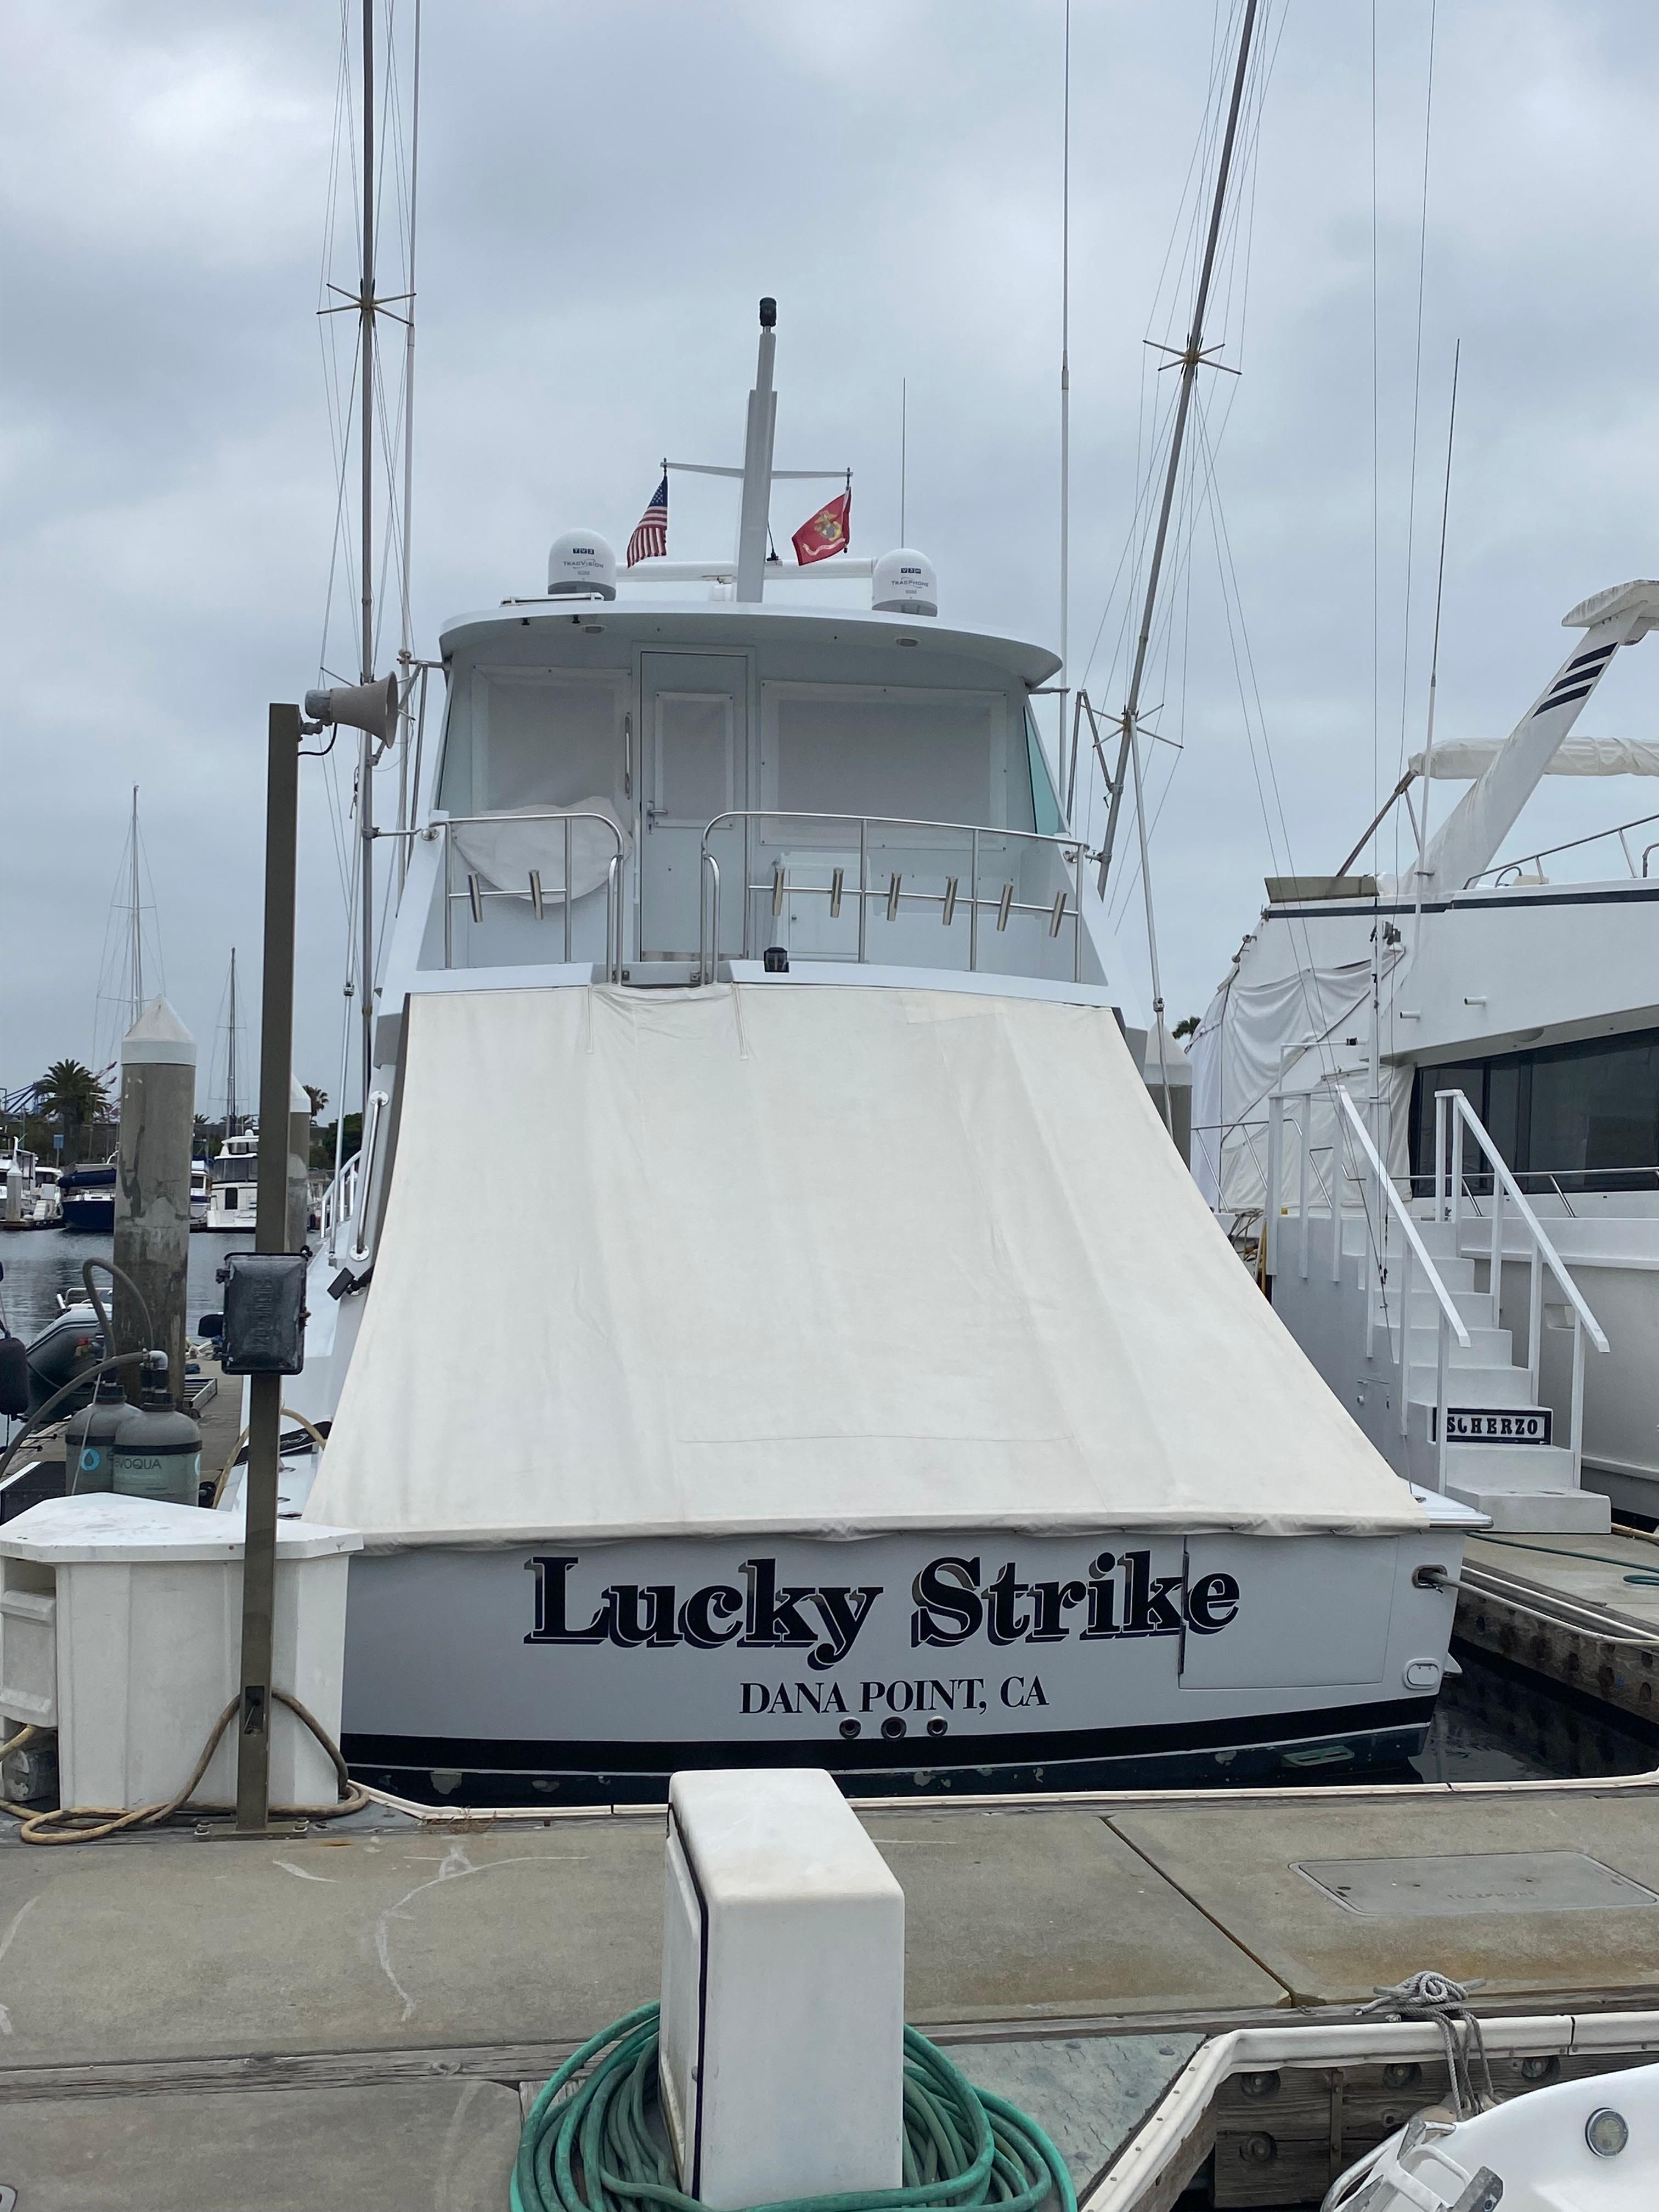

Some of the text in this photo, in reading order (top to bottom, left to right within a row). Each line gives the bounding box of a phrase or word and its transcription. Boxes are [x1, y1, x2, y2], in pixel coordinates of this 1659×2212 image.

[1447, 1417, 1538, 1435] SCHERZO
[523, 1549, 1241, 1671] Lucky Strike
[738, 1675, 1050, 1716] DANA POINT, CA
